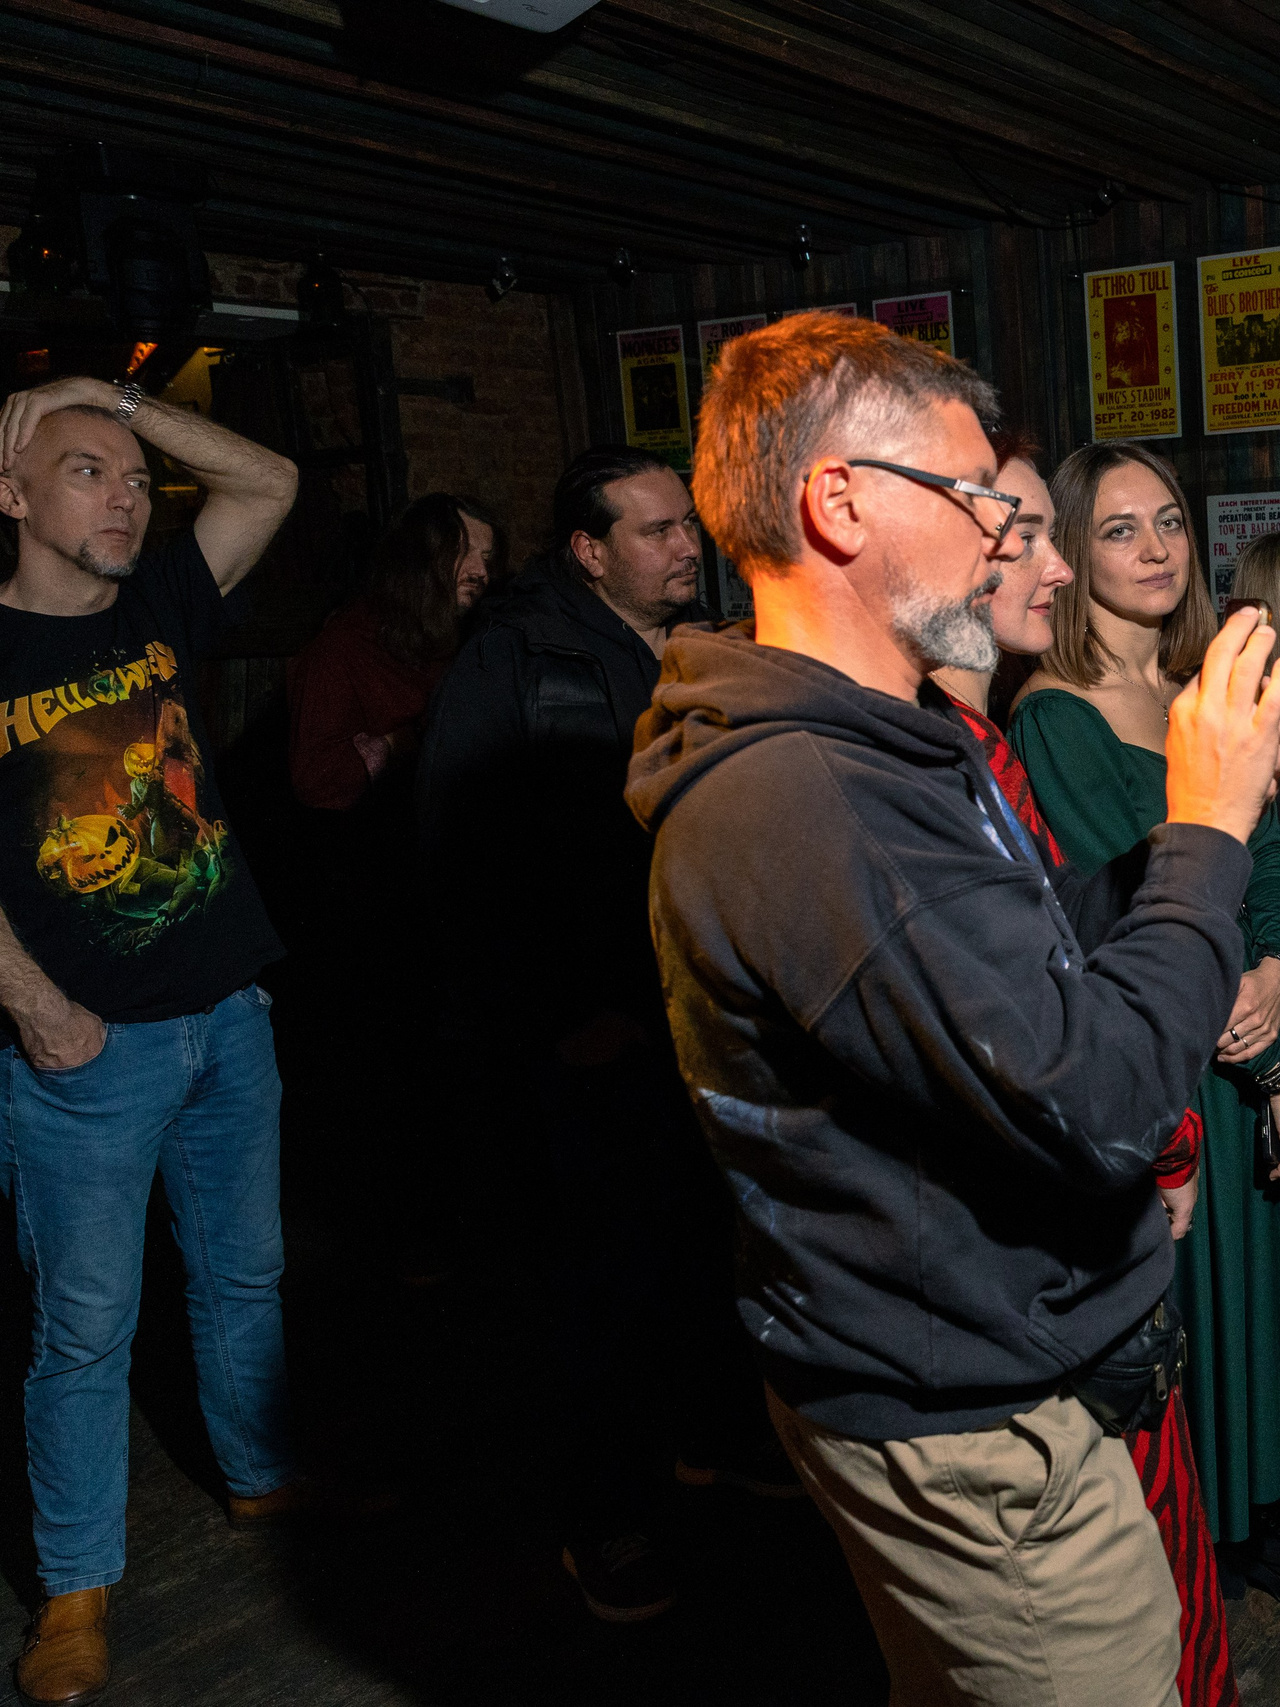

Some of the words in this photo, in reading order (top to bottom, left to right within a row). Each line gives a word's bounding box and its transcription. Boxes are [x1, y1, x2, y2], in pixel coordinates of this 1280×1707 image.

[1232, 255, 1261, 268] LIVE
[1090, 273, 1136, 299] JETHRO
[1139, 269, 1169, 293] TULL
[1207, 293, 1236, 317] BLUES
[917, 320, 950, 342] BLUES
[1207, 370, 1245, 383] JERRY
[1130, 387, 1171, 404] STADIUM
[1212, 381, 1240, 396] JULY
[1212, 399, 1261, 416] FREEDOM
[1094, 412, 1128, 425] SEPT.
[1218, 513, 1253, 523] OPERATION
[1255, 512, 1266, 521] BIG
[1218, 524, 1247, 536] TOWER
